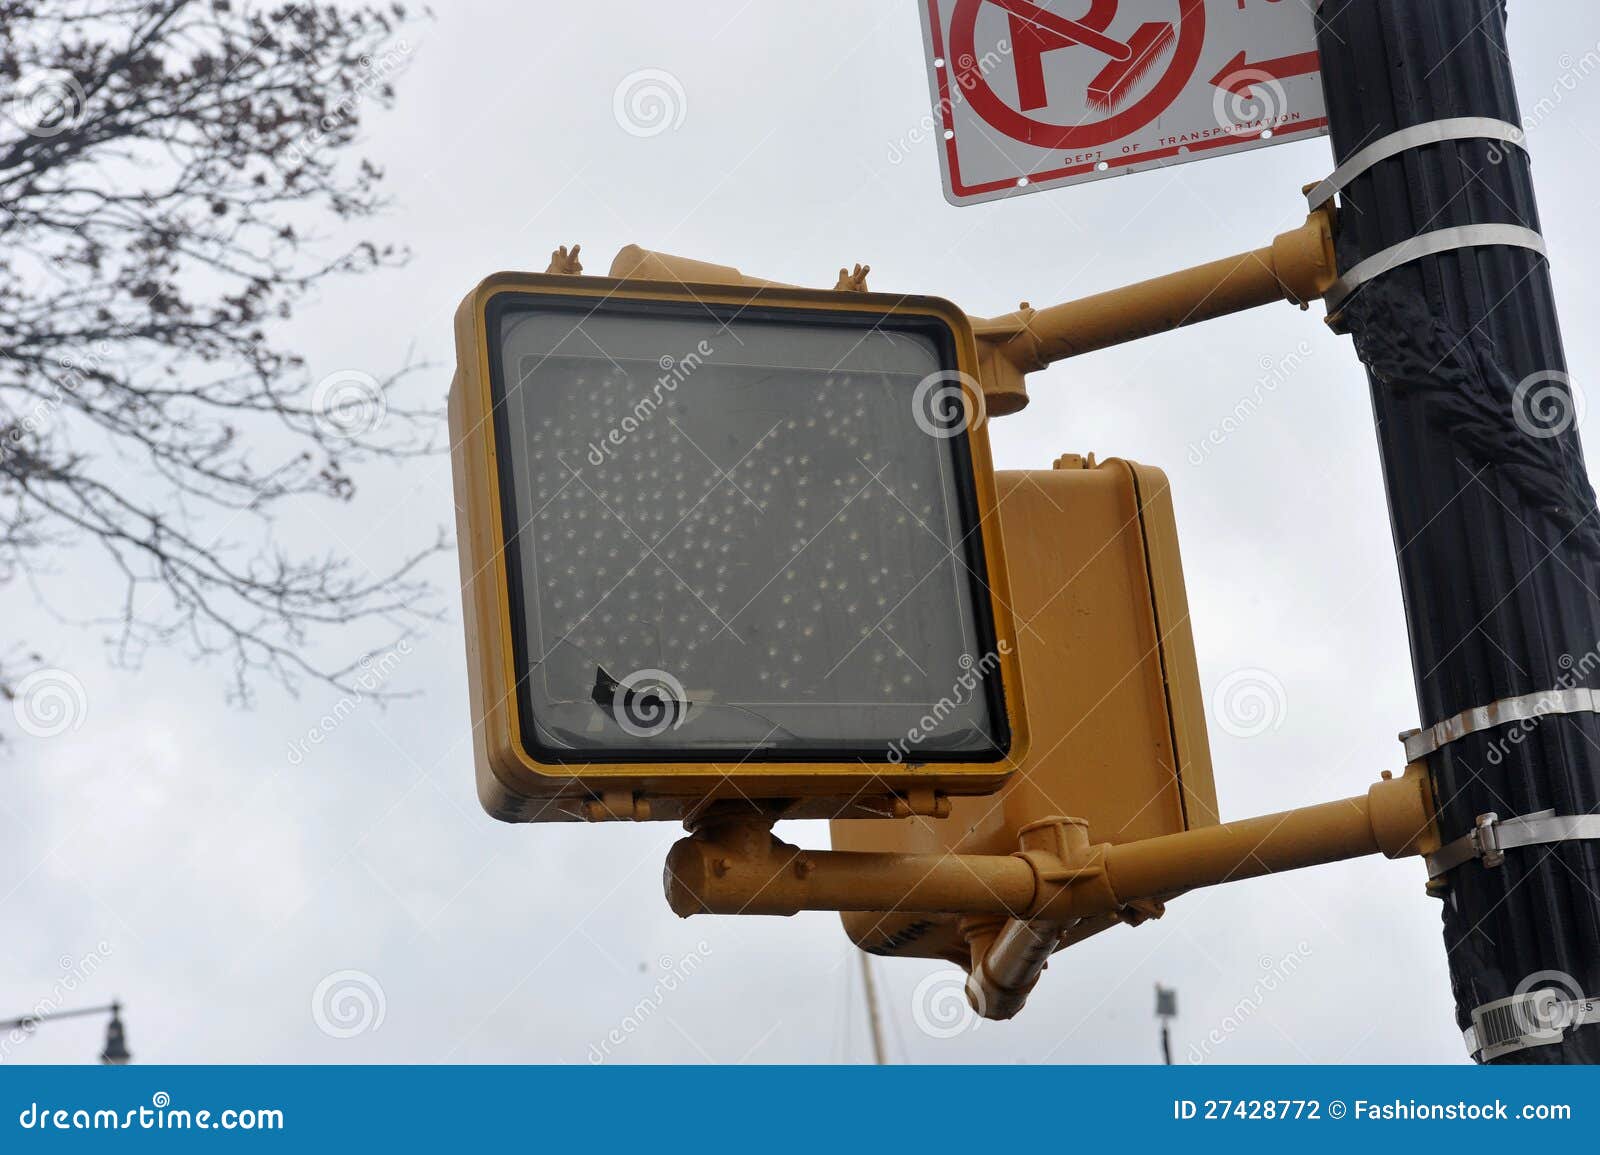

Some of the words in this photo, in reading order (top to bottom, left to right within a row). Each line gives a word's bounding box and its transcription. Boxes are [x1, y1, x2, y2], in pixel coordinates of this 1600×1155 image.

[1064, 151, 1103, 165] DEPT
[1122, 143, 1140, 153] OF
[1159, 112, 1301, 146] TRANSPORTATION
